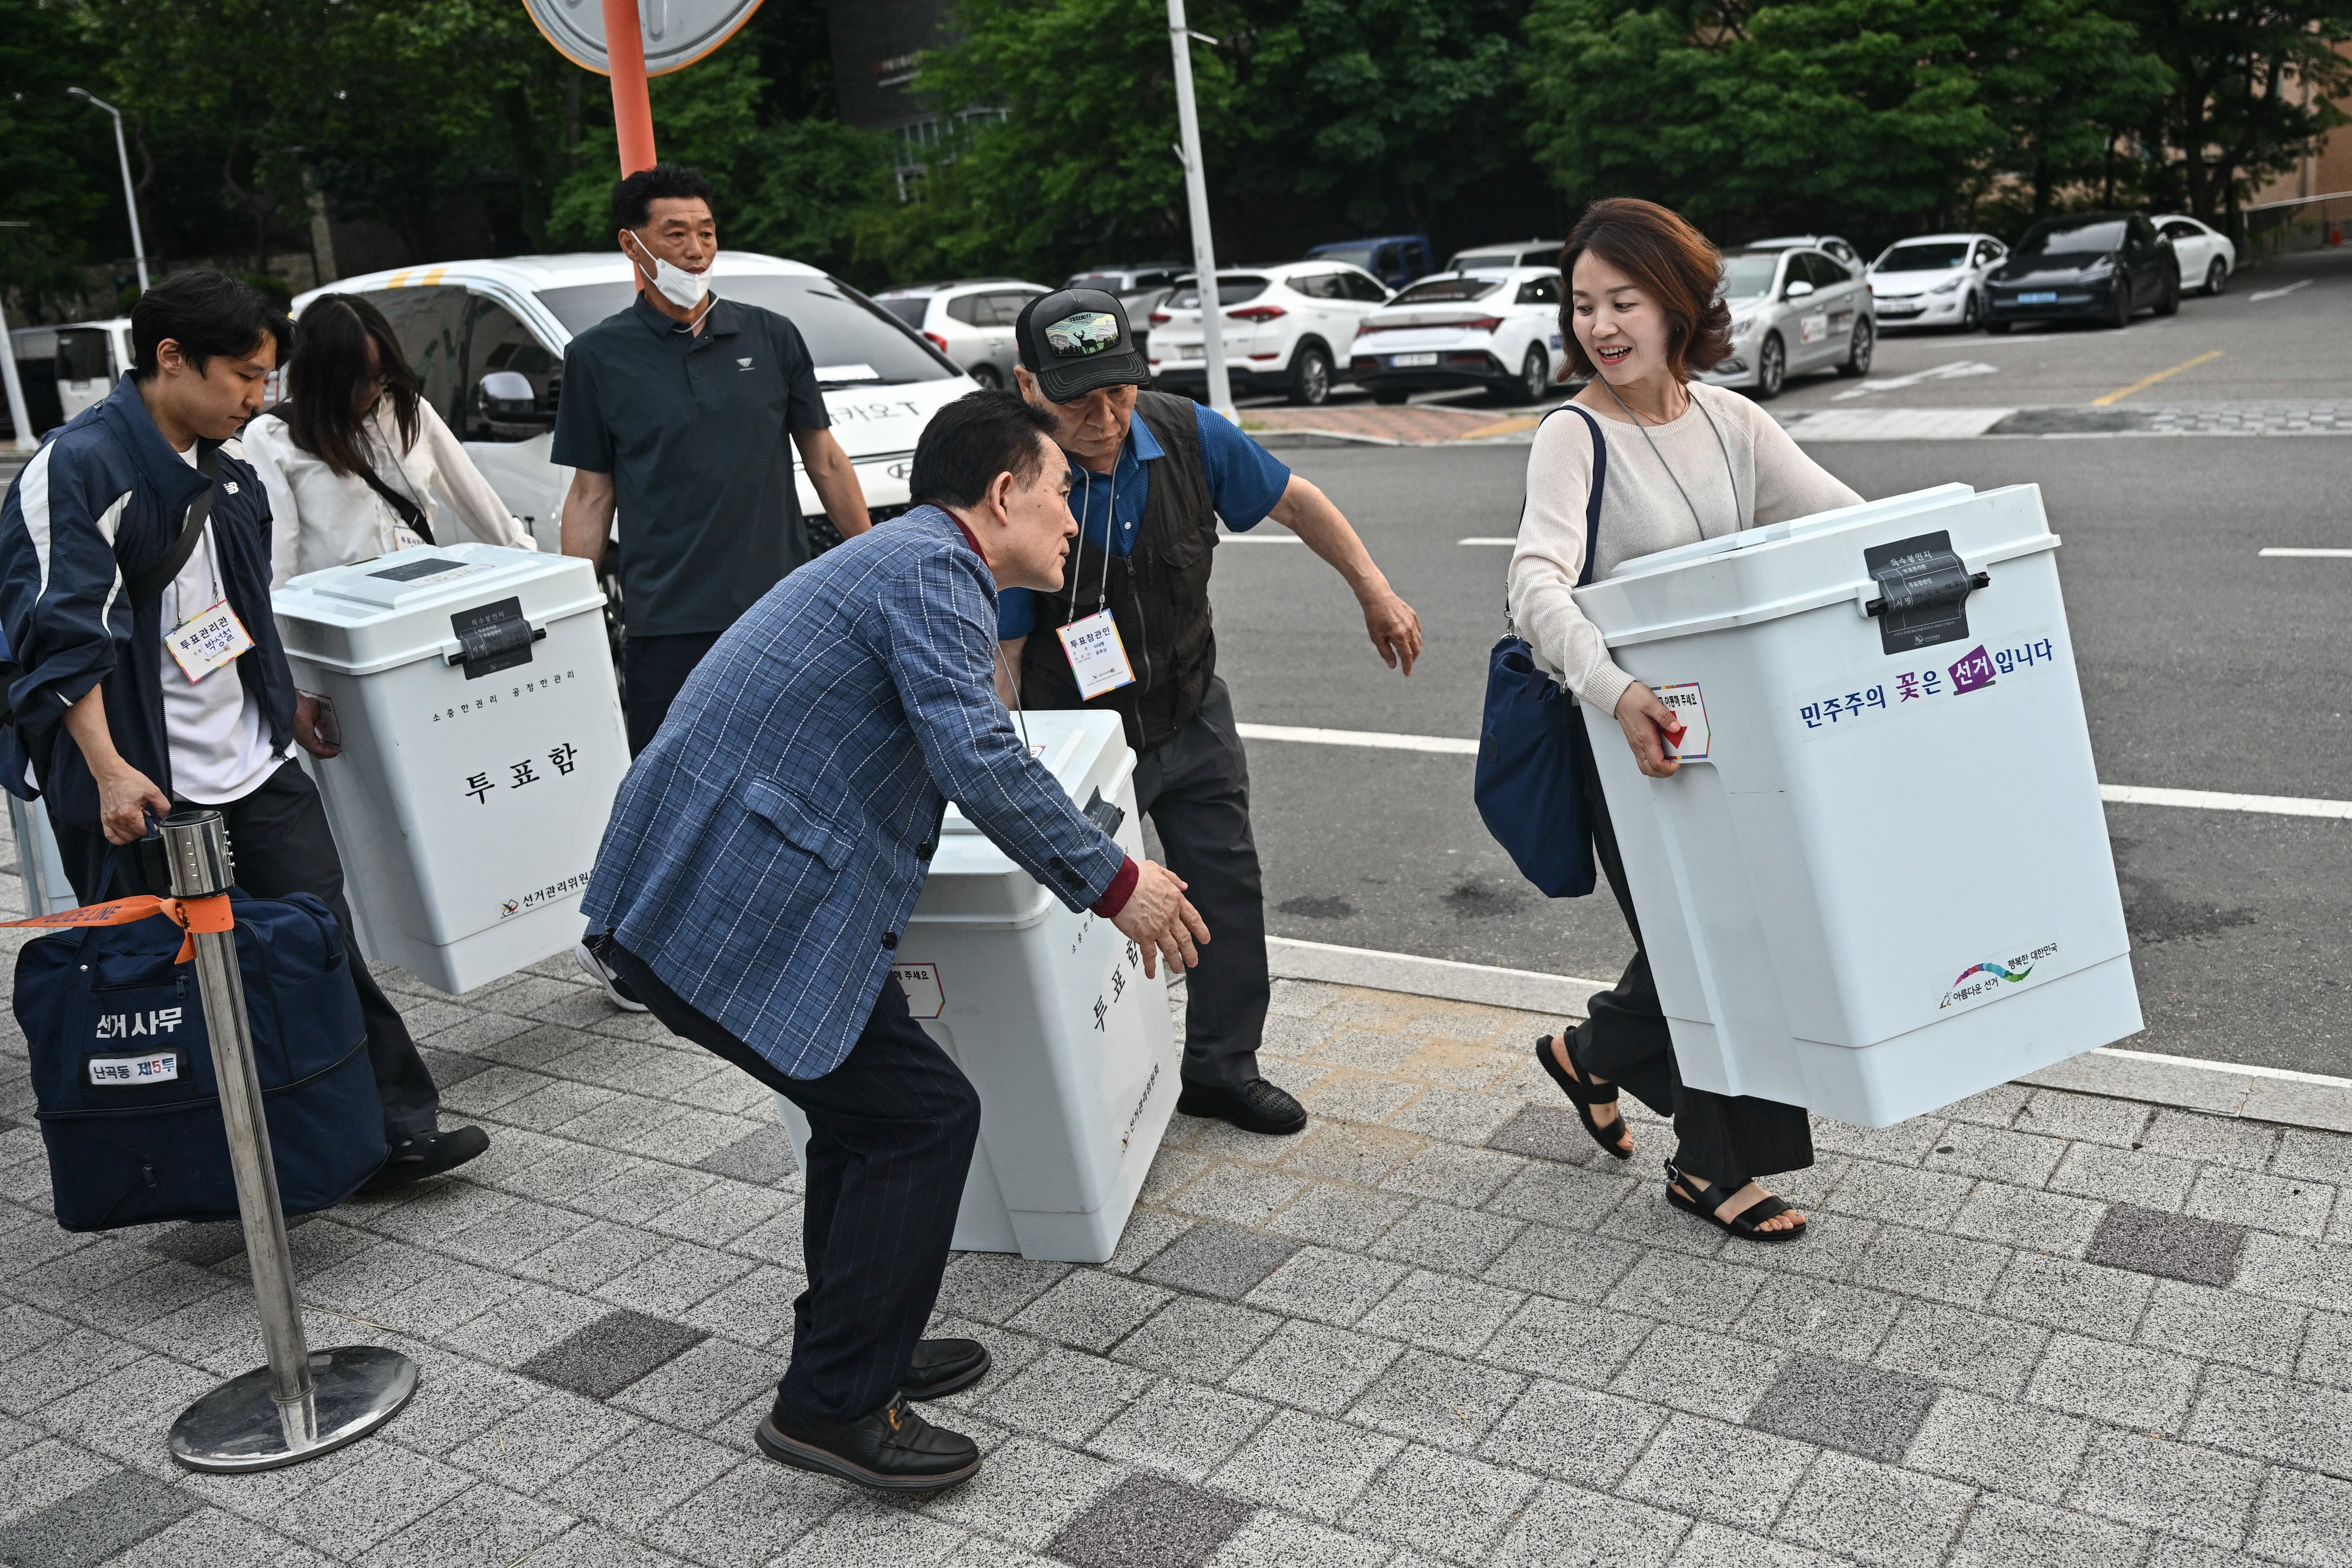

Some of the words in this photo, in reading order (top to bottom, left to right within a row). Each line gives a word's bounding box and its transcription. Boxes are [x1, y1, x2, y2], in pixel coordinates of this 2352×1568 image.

[1069, 313, 1092, 322] YOSEMITE
[1890, 550, 1933, 567] 특수봉인지
[1902, 564, 1927, 574] 투표관리관
[1908, 577, 1933, 589] 투표참관인
[180, 616, 229, 650] 투표관리관
[204, 627, 235, 651] 박성철
[1070, 626, 1111, 649] 투표참관인
[1664, 695, 1681, 708] 이동해
[1680, 693, 1697, 706] 주세요
[1799, 685, 1886, 729] 민주주의
[1895, 670, 1941, 703] 꽃은
[465, 743, 578, 805] 투표함
[523, 870, 593, 907] 선거관리위원
[83, 906, 121, 921] LINE
[2007, 953, 2029, 970] 행복한
[2030, 942, 2058, 961] 대한민국
[904, 970, 929, 980] 주세요
[1953, 983, 1982, 1001] 아름다운
[1984, 977, 1999, 991] 선거
[96, 1014, 127, 1038] 선거
[131, 1007, 182, 1037] 사무
[94, 1065, 130, 1079] 난곡동
[137, 1057, 175, 1076] 제5투
[1130, 1062, 1159, 1133] 선거관리위원회
